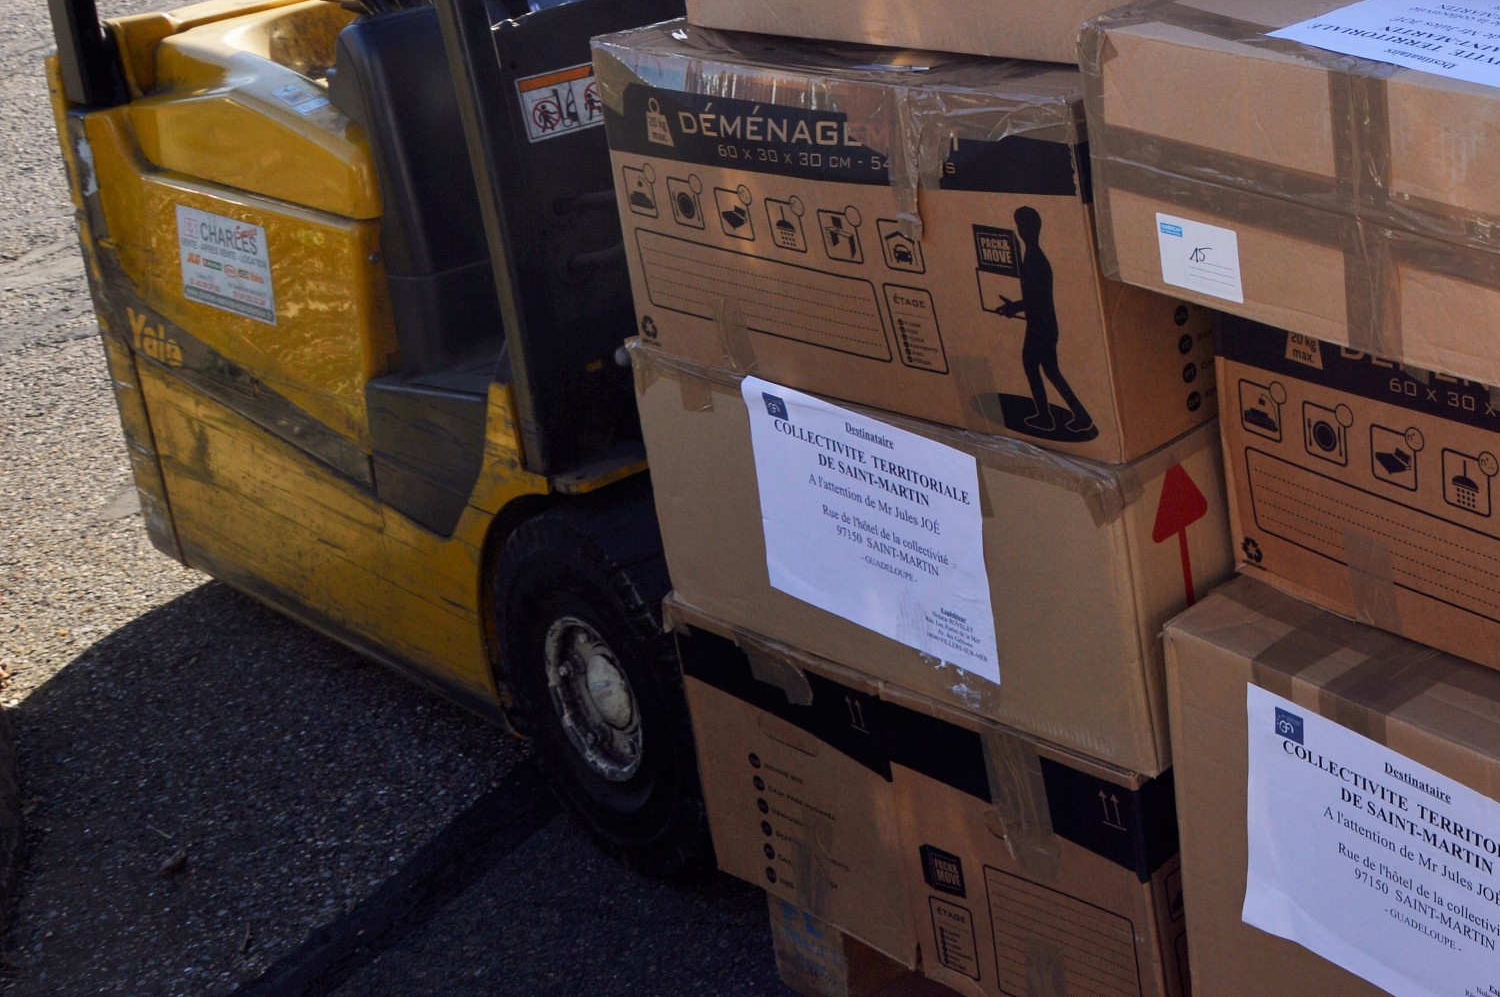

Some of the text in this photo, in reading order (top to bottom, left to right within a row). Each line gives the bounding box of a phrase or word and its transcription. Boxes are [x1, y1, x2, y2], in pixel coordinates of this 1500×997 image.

[1308, 23, 1447, 57] TERRITORIALE
[648, 117, 659, 127] 20
[652, 131, 669, 143] max.
[718, 144, 737, 158] 60
[743, 149, 751, 160] x
[757, 148, 778, 162] 30
[784, 153, 792, 164] x
[799, 153, 822, 166] 30
[829, 156, 851, 169] CM
[200, 222, 258, 255] CHARLES
[981, 236, 1010, 250] PACK&
[983, 248, 1012, 264] MOVE
[1190, 247, 1212, 263] 15
[893, 293, 926, 308] ÉTAGE
[126, 306, 183, 366] Yale
[1292, 348, 1315, 364] max.
[1389, 378, 1418, 397] 60
[1427, 388, 1437, 402] x
[1448, 390, 1475, 412] 30
[1484, 402, 1496, 417] x
[845, 422, 894, 449] Destinataire
[774, 420, 969, 505] COLLECTIVITE TERRITORIALE
[819, 454, 929, 506] DE SAINT-MARTIN
[809, 474, 940, 535] A l'attention de Mr Jules JOÉ
[823, 505, 948, 564] Rue de l'hôtel de la collectivité
[837, 525, 939, 576] 97150 SAINT-MARTIN
[1283, 740, 1408, 814] COLLECTIVITE
[1385, 762, 1451, 804] Destinataire
[1324, 807, 1333, 824] A
[1337, 813, 1395, 854] l'attention
[1399, 843, 1413, 863] de
[1418, 852, 1437, 875] Mr
[1442, 864, 1473, 892] Jules
[1341, 787, 1493, 875] DE SAINT-MARTIN
[1338, 843, 1359, 865] Rue
[1363, 855, 1376, 873] de
[1379, 863, 1412, 891] l'hôtel
[1416, 882, 1429, 900] de
[1433, 890, 1443, 907] la
[1355, 869, 1495, 951] 97150 SAINT-MARTIN
